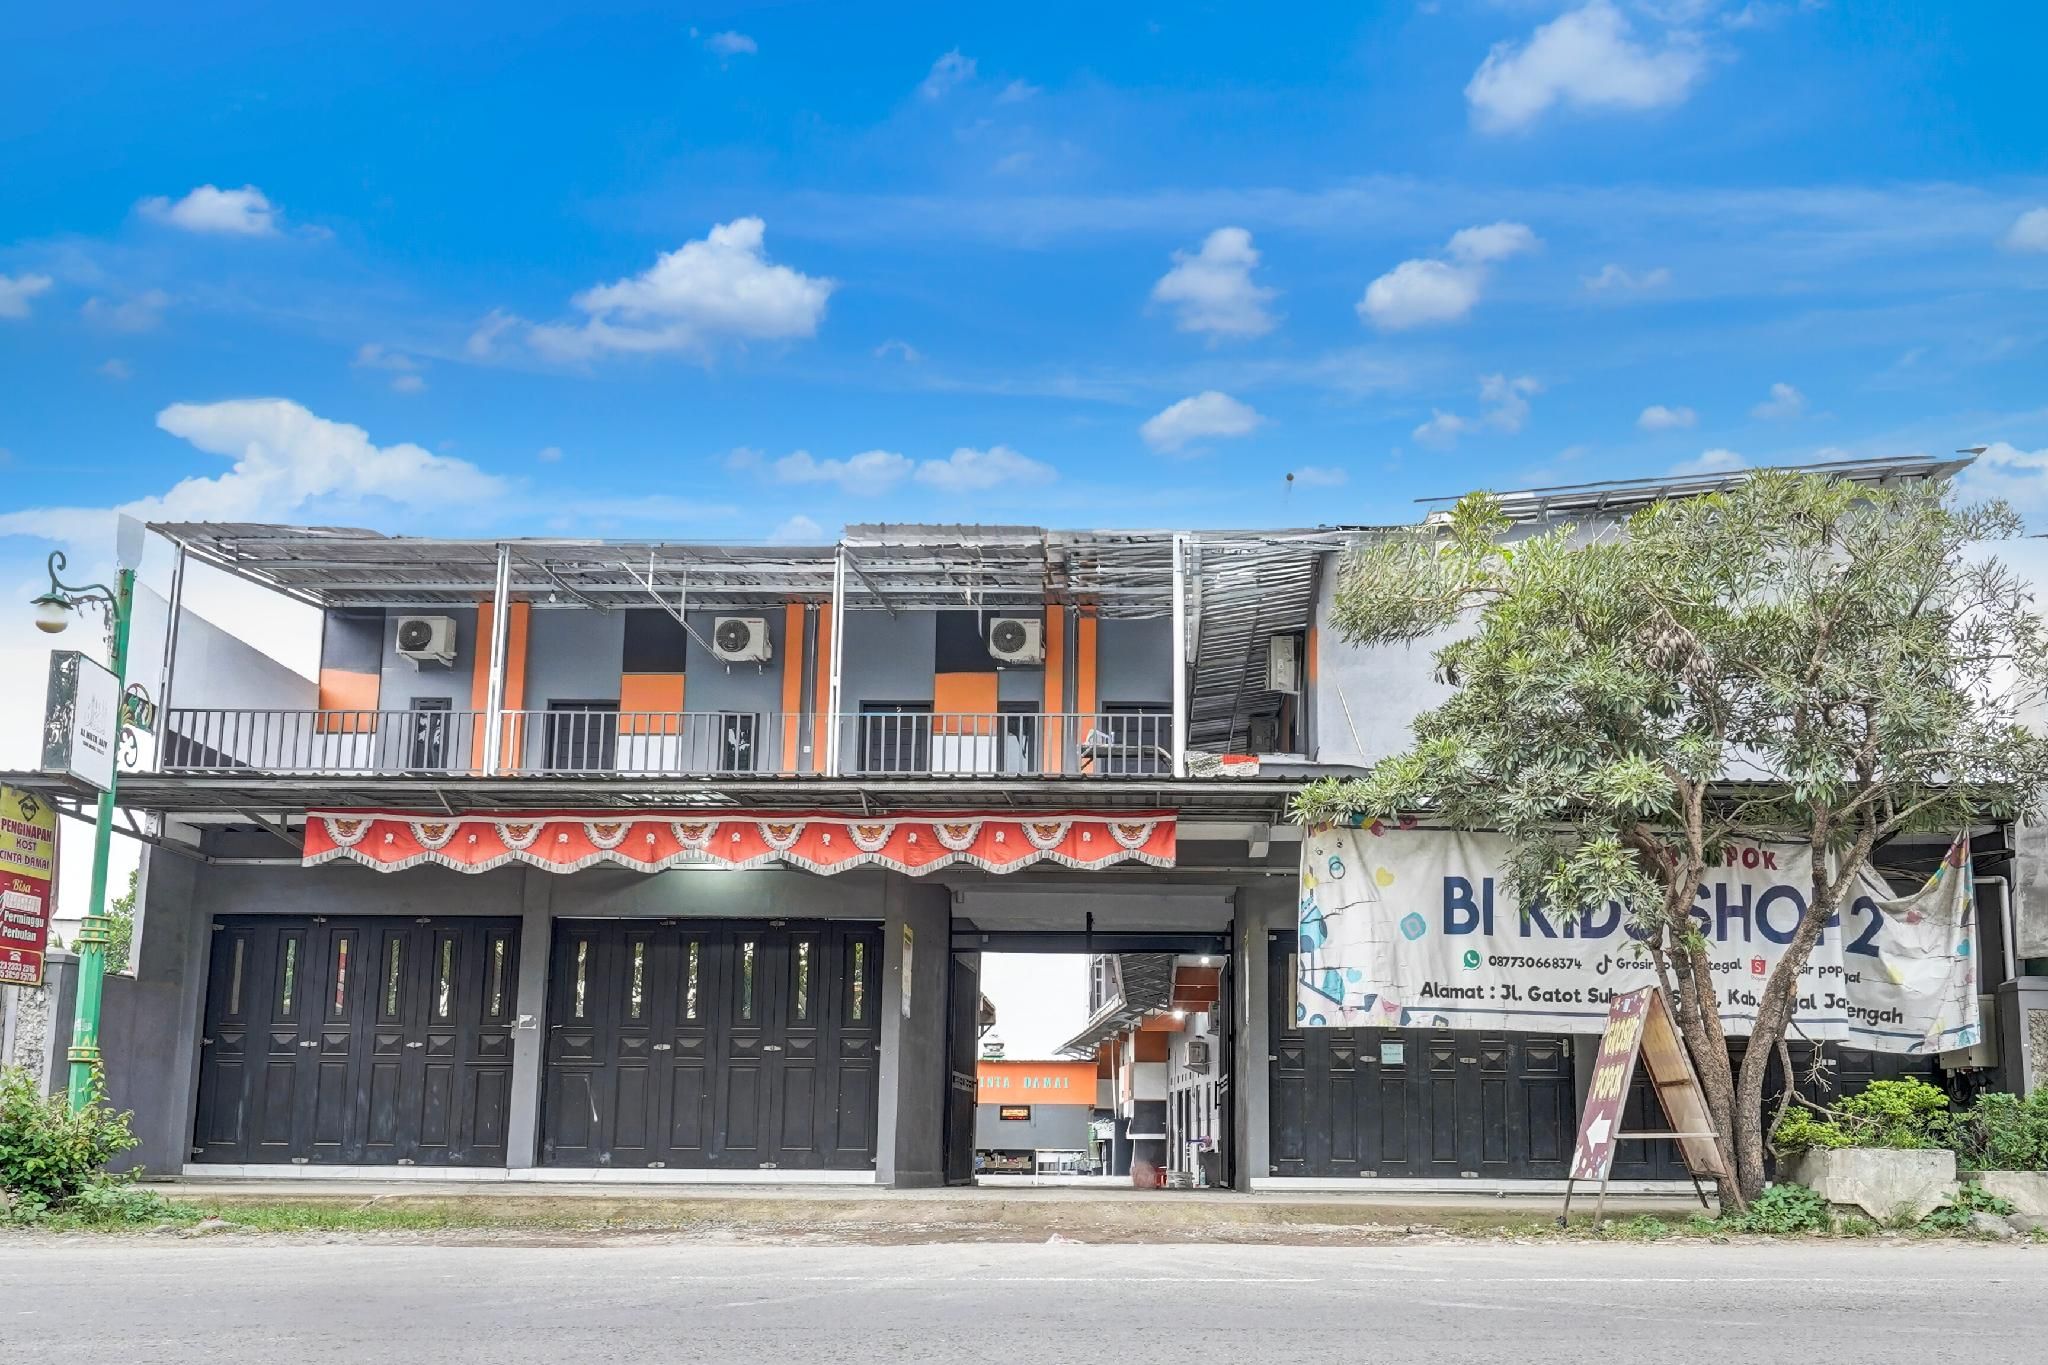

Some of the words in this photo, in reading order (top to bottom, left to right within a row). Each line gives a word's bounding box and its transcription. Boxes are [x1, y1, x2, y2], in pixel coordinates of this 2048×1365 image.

[1, 818, 52, 842] PENGINAPAN
[0, 850, 22, 864] CINTA
[24, 855, 50, 870] DAMAI
[12, 878, 32, 894] Bisa
[4, 910, 45, 928] Perminggu
[1443, 876, 1494, 936] BI
[1845, 895, 1884, 958] 2
[2, 925, 37, 942] Perbulan
[1488, 955, 1582, 969] 087730668374
[1420, 981, 1485, 999] Alamat
[1500, 984, 1523, 1002] Jl.
[1527, 985, 1583, 1003] Gatot
[1847, 1005, 1904, 1027] engah
[979, 1075, 1010, 1089] INTA
[1023, 1075, 1069, 1089] DAMAI
